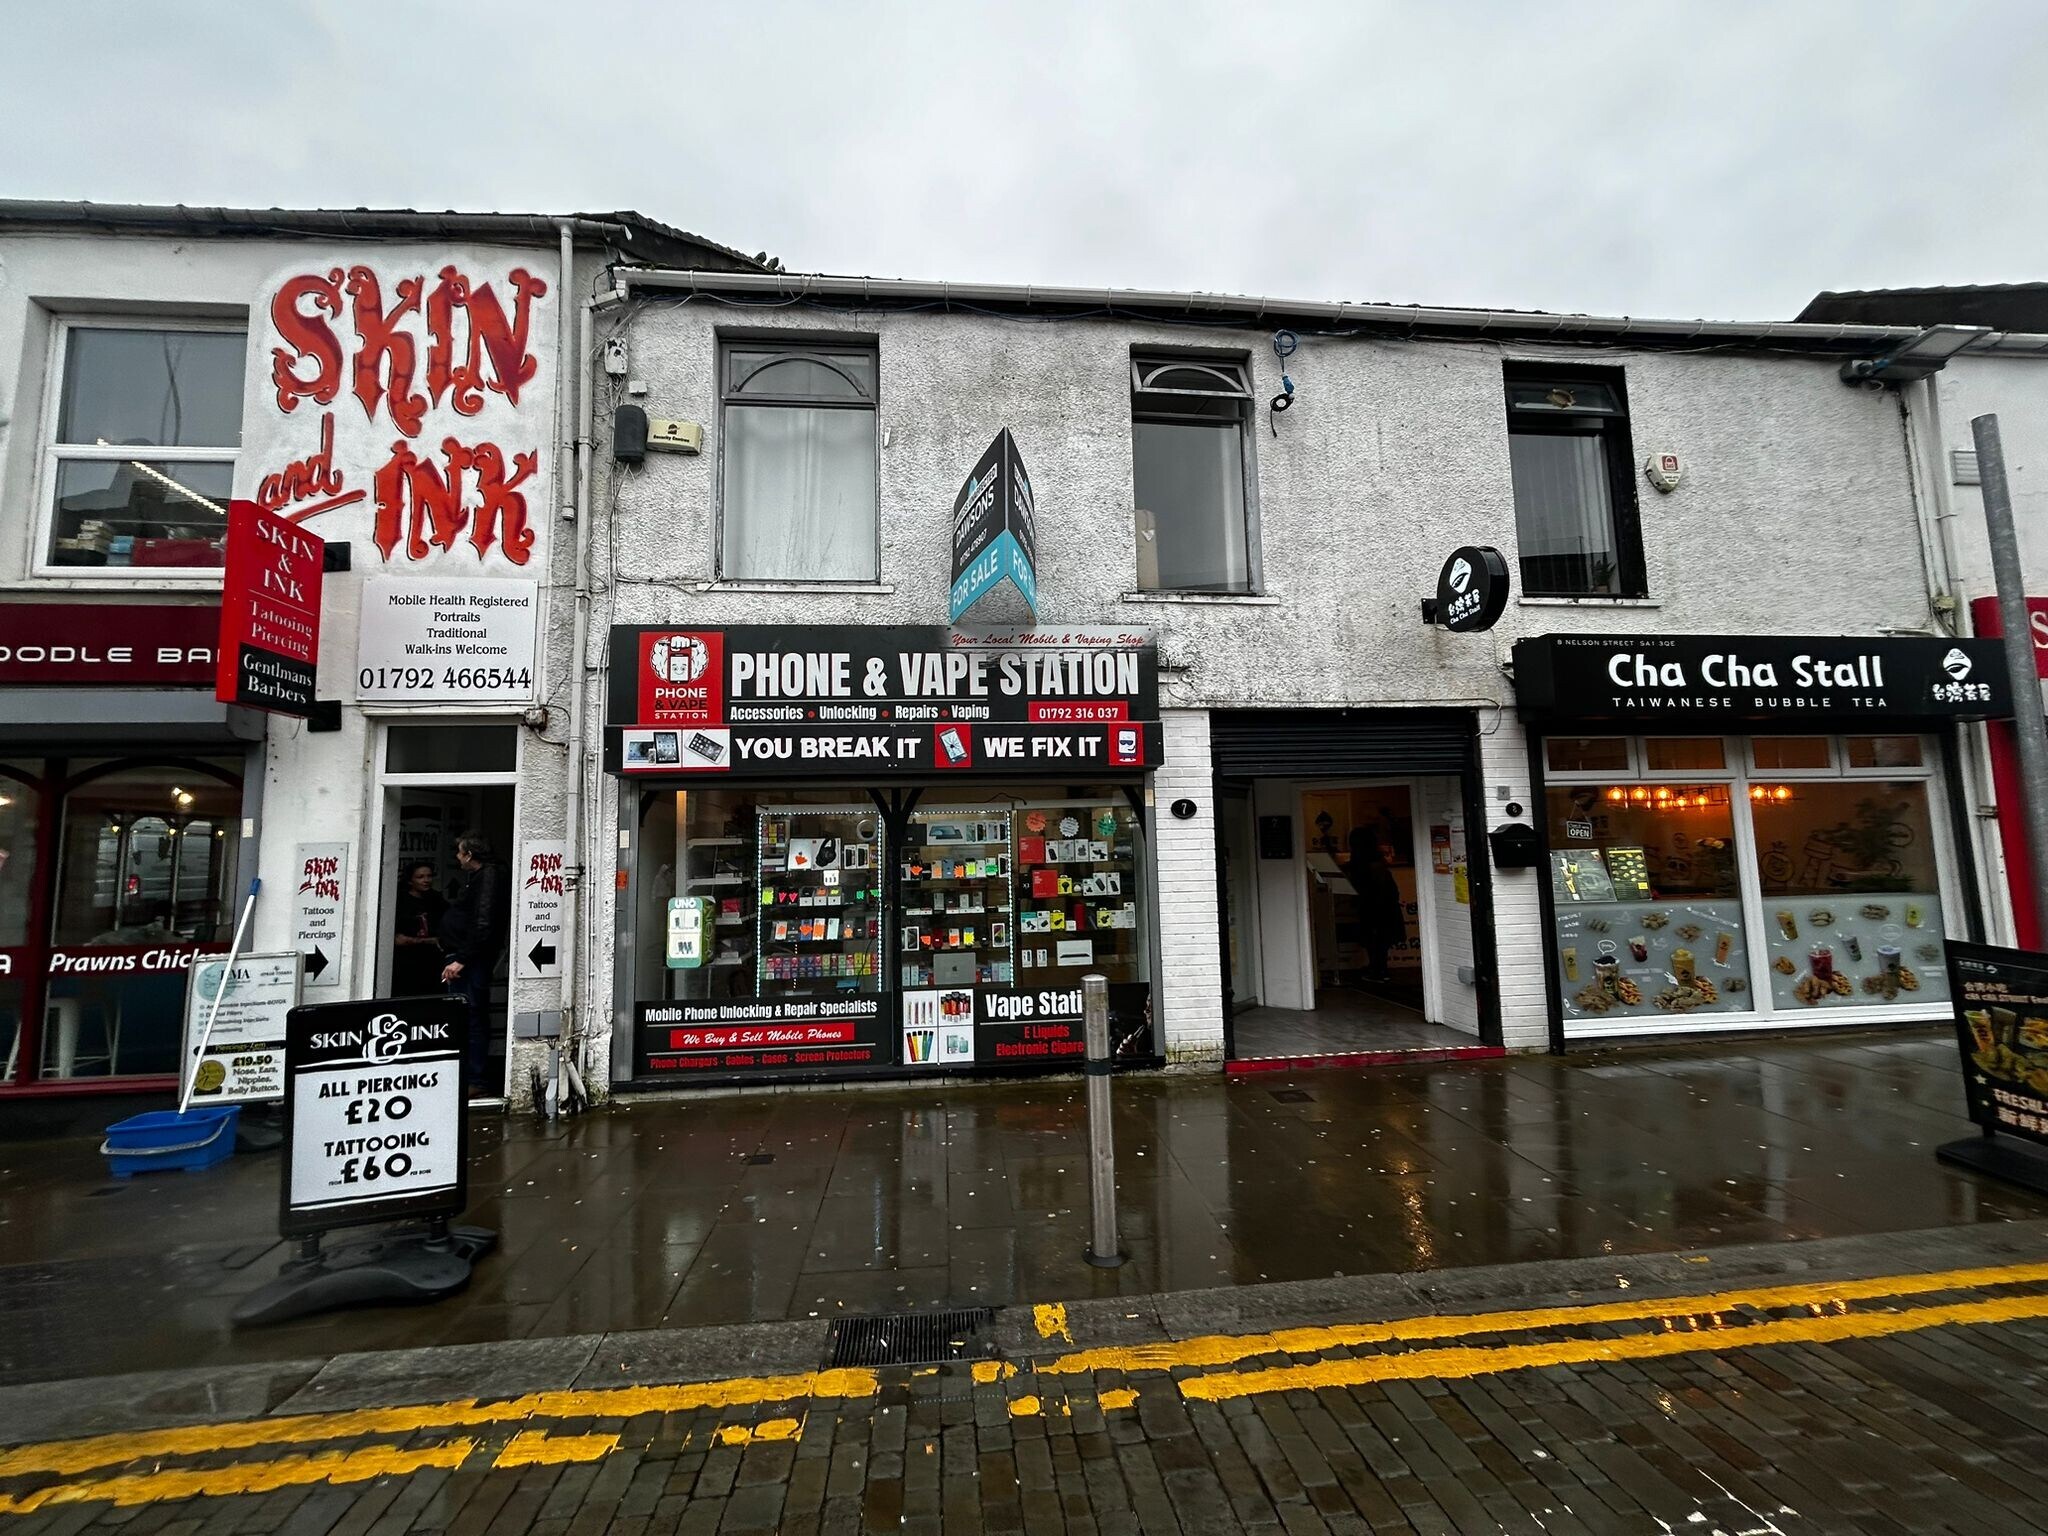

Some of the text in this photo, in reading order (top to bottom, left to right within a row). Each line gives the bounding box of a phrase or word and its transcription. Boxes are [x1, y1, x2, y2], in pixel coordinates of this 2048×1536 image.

[271, 265, 547, 438] SKIN
[257, 412, 538, 565] and INK
[956, 485, 994, 549] DAWSONS
[256, 519, 316, 561] SKIN
[278, 554, 292, 574] &
[263, 569, 305, 602] INK
[952, 582, 969, 611] FOR
[970, 549, 998, 593] SALE
[389, 595, 529, 609] Mobile Health Registered
[250, 600, 313, 641] Tatooing
[434, 612, 481, 622] Portraits
[251, 622, 309, 660] Piercing
[426, 628, 487, 639] Traditional
[951, 633, 1145, 646] Your Local Mobile & Vaping Shop
[157, 648, 220, 663] BA
[405, 644, 508, 655] Walk-ins Welcome
[243, 652, 312, 687] Gentlmans
[360, 667, 532, 689] 01792 466544
[731, 652, 1139, 697] PHONE & VAPE STATION
[1608, 653, 1884, 688] Cha Cha Stall
[247, 675, 307, 704] Barbers
[655, 687, 708, 699] PHONE
[655, 700, 708, 710] & VAPE
[730, 704, 990, 721] Accessories Unlocking Repairs Vaping
[1612, 698, 1888, 708] TAIWANESE BUBBLE TEA
[655, 712, 708, 720] STATION
[1039, 708, 1119, 719] 01792 316 037
[735, 736, 922, 759] YOU BREAK IT
[983, 736, 1102, 758] WE FIX IT
[1181, 803, 1187, 815] 7
[1570, 828, 1590, 837] OPEN
[303, 856, 339, 879] SKIN
[530, 853, 563, 876] SKIN
[315, 878, 340, 901] INK
[540, 874, 563, 897] INK
[302, 907, 335, 915] Tattoos
[528, 901, 558, 909] Tattoos
[309, 919, 326, 927] and
[535, 912, 551, 921] and
[298, 931, 336, 940] Piercings
[525, 924, 561, 933] Piercings
[49, 952, 136, 972] Prawns
[645, 1000, 878, 1022] Mobile Phone Unlocking & Repair Specialists
[985, 989, 1083, 1020] Vape Stati
[310, 1013, 449, 1064] SKIN & INK
[683, 1028, 842, 1046] We Buy & Sell Mobile Phones
[1024, 1025, 1070, 1039] E Liquids
[996, 1040, 1085, 1057] Electronic Cigare
[232, 1055, 273, 1067] £19.50
[650, 1049, 871, 1069] Phone Chargers Cables Cases Screen Protectors
[228, 1086, 249, 1095] Belly
[318, 1072, 439, 1099] ALL PIERCINGS
[344, 1095, 412, 1125] £20
[324, 1131, 430, 1157] TATTOOING
[340, 1153, 412, 1184] £60
